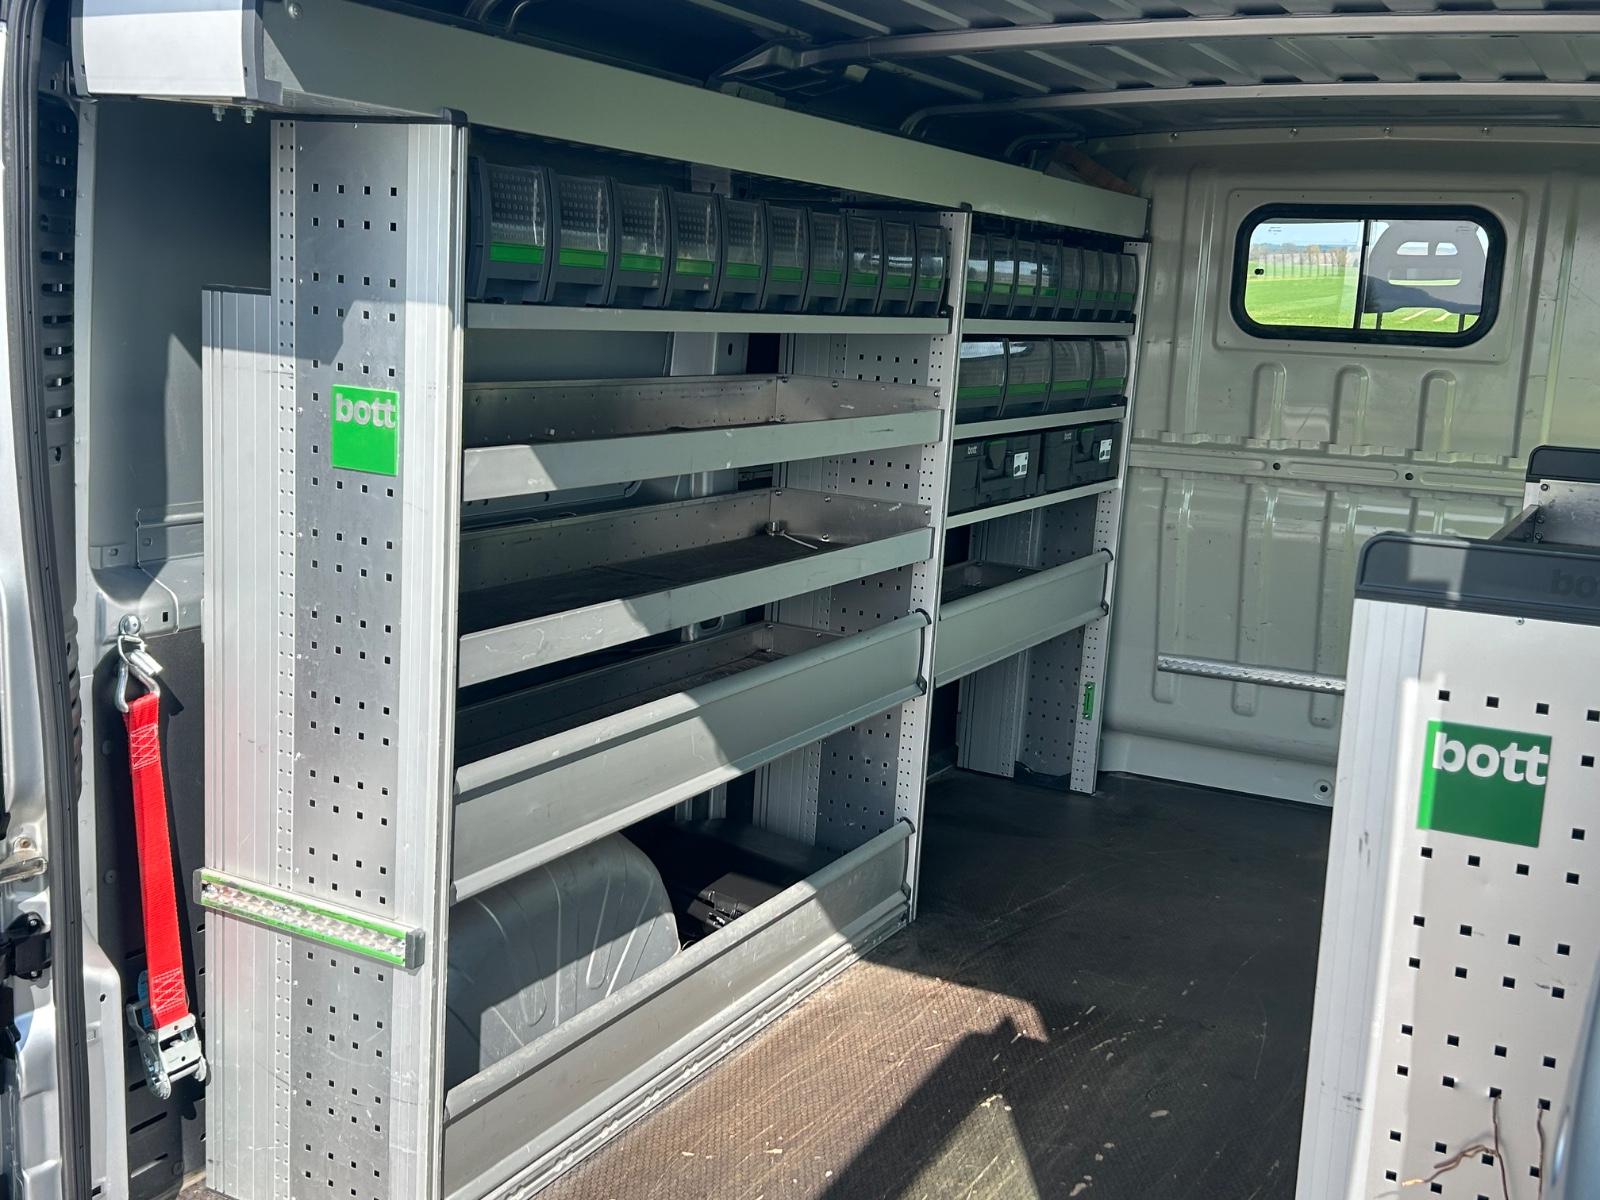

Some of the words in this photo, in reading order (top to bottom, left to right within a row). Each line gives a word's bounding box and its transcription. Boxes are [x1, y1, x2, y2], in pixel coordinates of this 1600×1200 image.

[335, 393, 396, 428] bott
[1551, 568, 1600, 600] bo
[1432, 731, 1548, 786] bott
